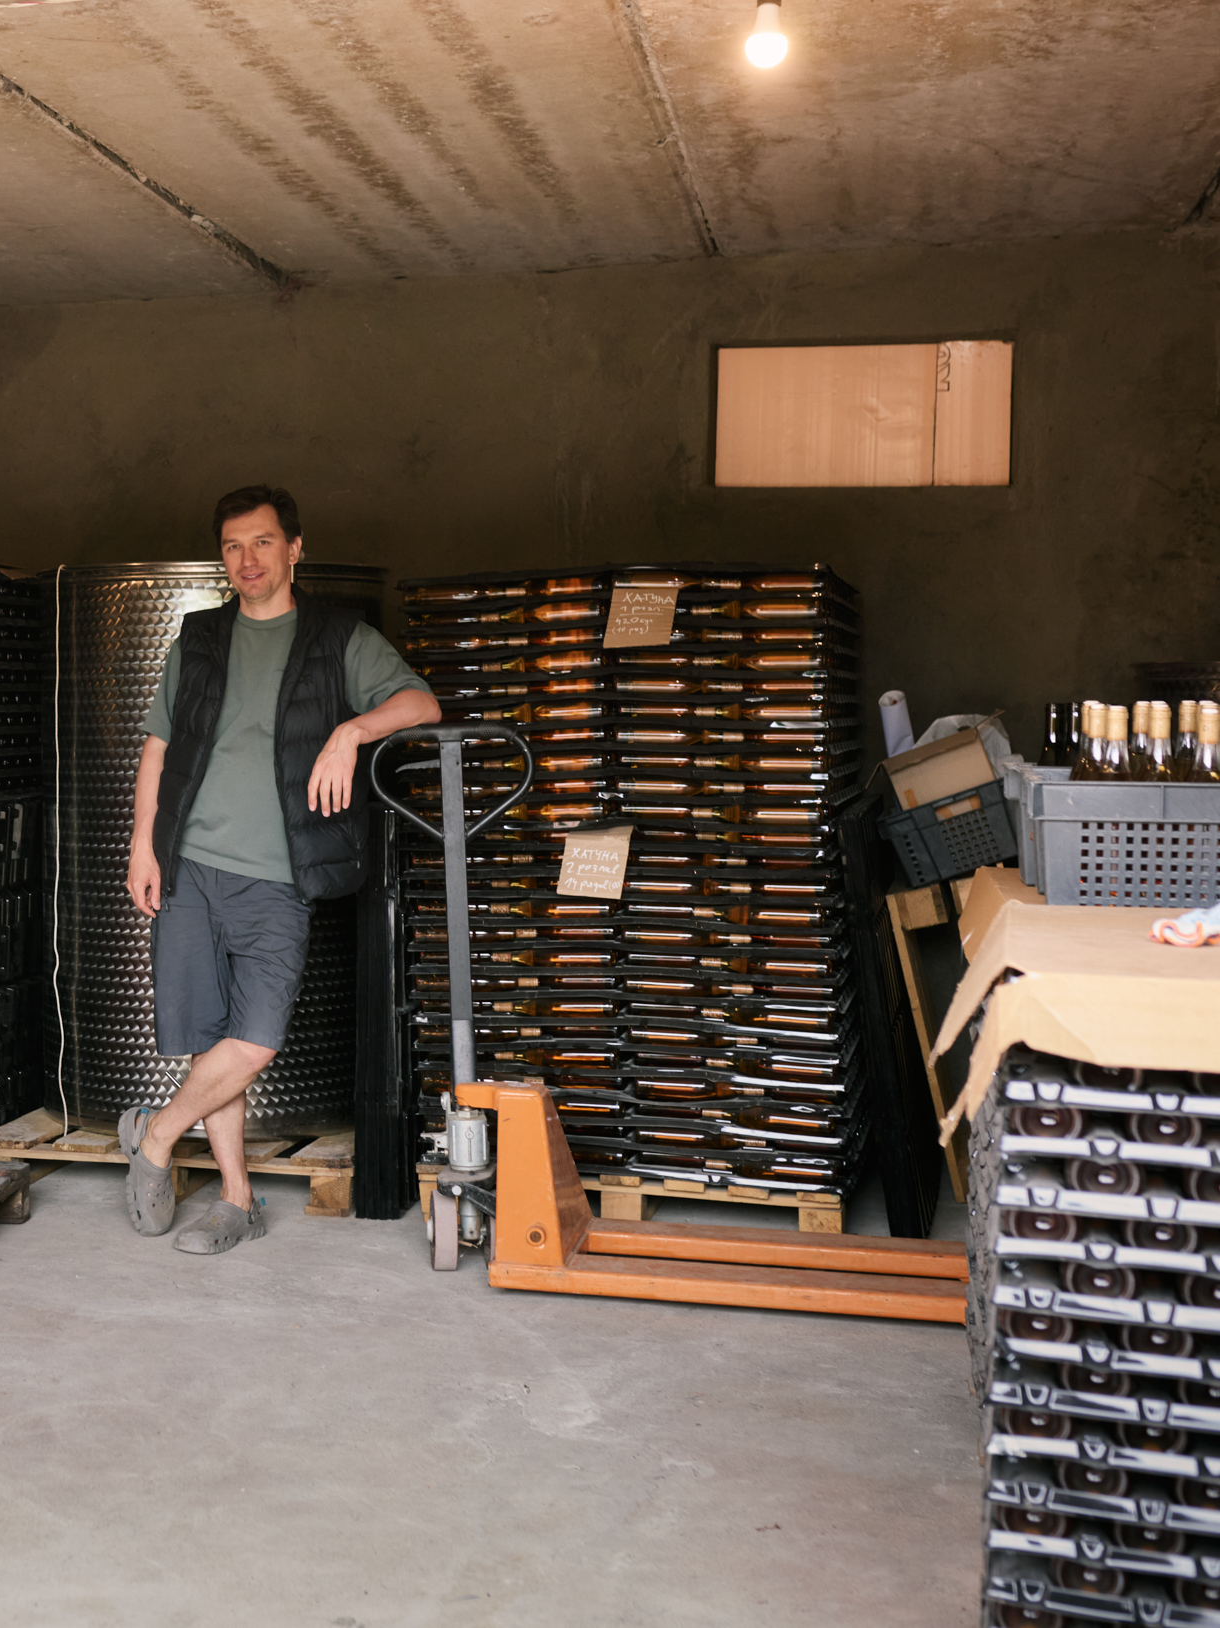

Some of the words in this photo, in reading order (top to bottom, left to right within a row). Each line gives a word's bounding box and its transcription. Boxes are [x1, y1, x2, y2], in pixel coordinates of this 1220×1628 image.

[571, 847, 619, 862] ХАТУНА
[565, 861, 575, 874] 2
[564, 877, 578, 891] 14
